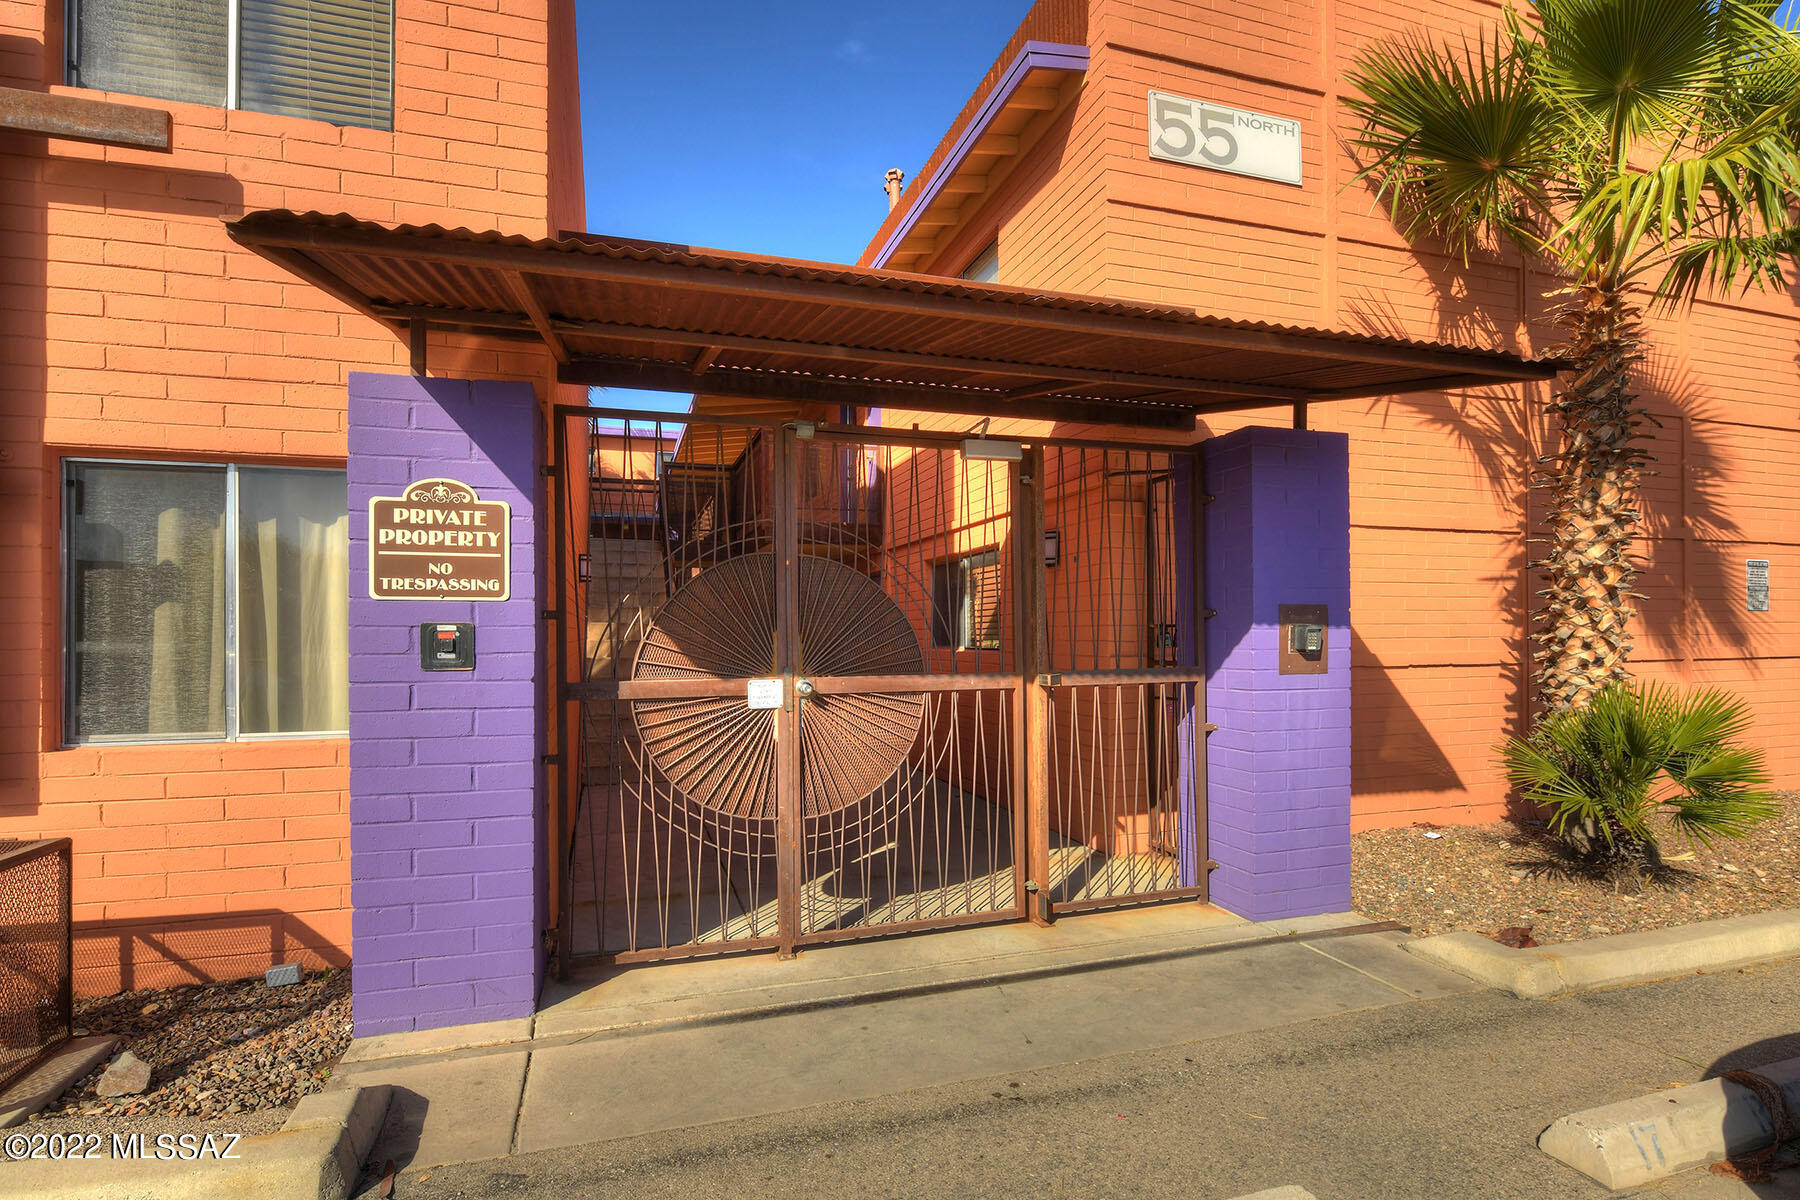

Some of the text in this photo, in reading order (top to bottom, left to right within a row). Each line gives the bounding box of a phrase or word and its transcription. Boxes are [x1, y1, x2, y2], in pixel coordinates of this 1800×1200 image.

[1154, 98, 1296, 166] 55 NORTH
[393, 508, 487, 526] PRIVATE
[378, 528, 501, 547] PROPERTY
[428, 562, 453, 575] NO
[379, 577, 500, 592] TRESPASSING
[1629, 1120, 1666, 1170] 17
